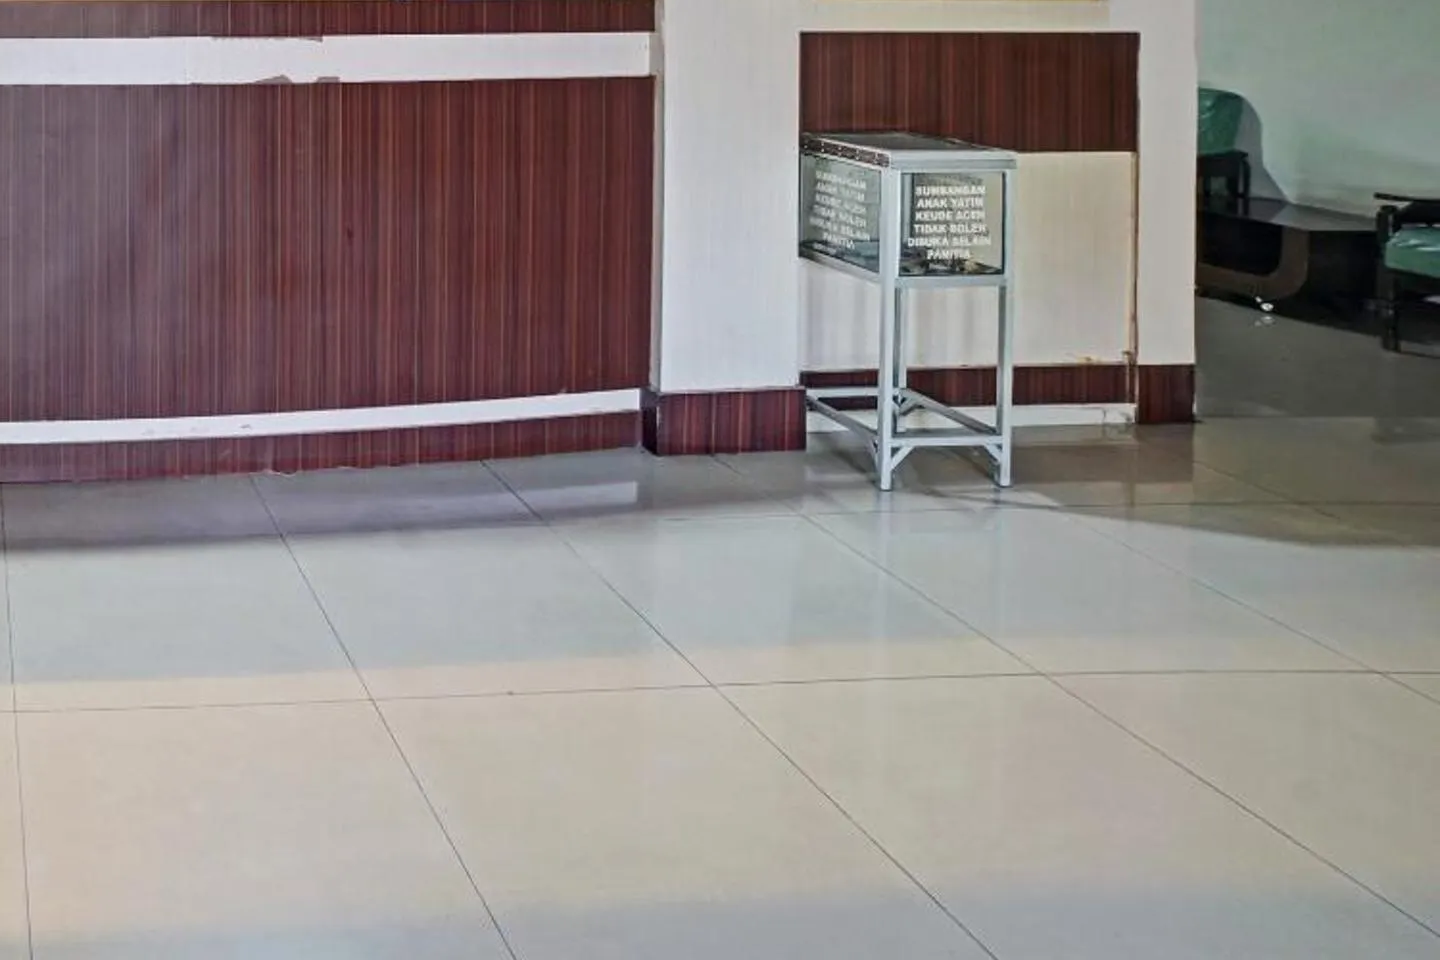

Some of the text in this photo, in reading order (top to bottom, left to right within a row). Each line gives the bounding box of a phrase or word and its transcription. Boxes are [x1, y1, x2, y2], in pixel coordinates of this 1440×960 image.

[915, 185, 986, 197] SUMBANGAN
[917, 197, 984, 208] ANAK YATIM
[913, 224, 947, 234] TIDAK
[907, 237, 949, 247] DIBUKA
